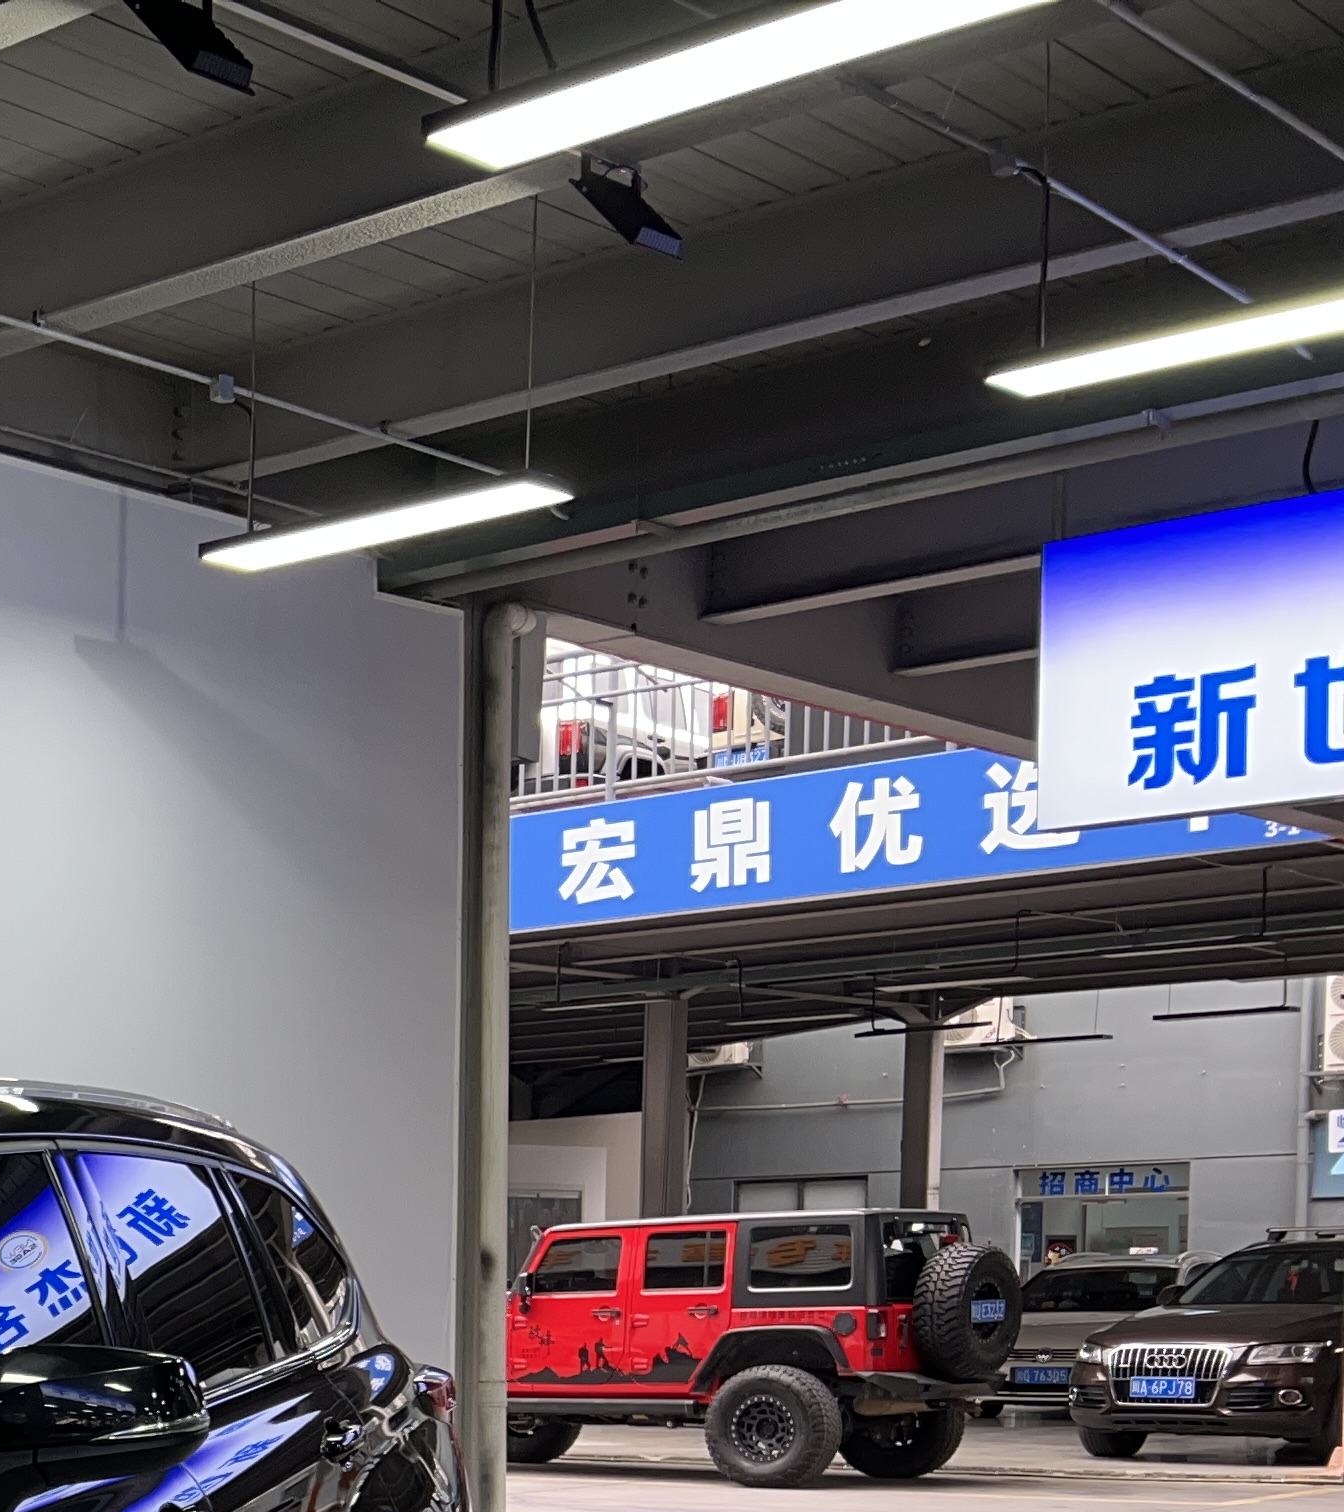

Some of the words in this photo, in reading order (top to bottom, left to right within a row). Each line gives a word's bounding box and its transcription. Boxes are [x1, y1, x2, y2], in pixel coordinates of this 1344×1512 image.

[558, 761, 1210, 905] 宏鼎优选
[1039, 1167, 1170, 1196] 招商中心
